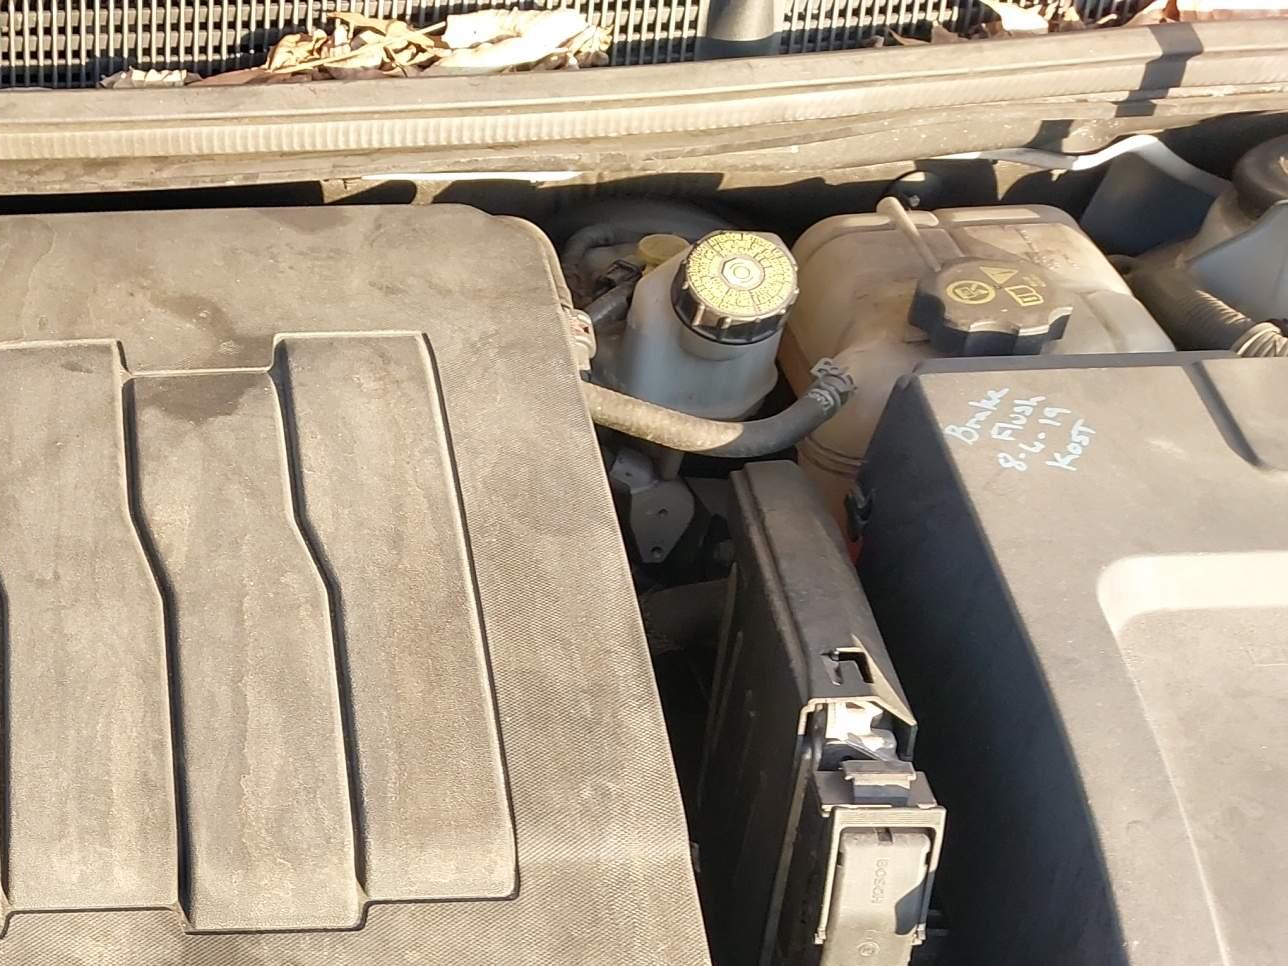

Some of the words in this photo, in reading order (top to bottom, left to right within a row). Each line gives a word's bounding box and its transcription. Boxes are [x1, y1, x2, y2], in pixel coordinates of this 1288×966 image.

[944, 388, 1009, 445] Brake
[991, 396, 1047, 441] Flush
[871, 858, 889, 904] BOSCH
